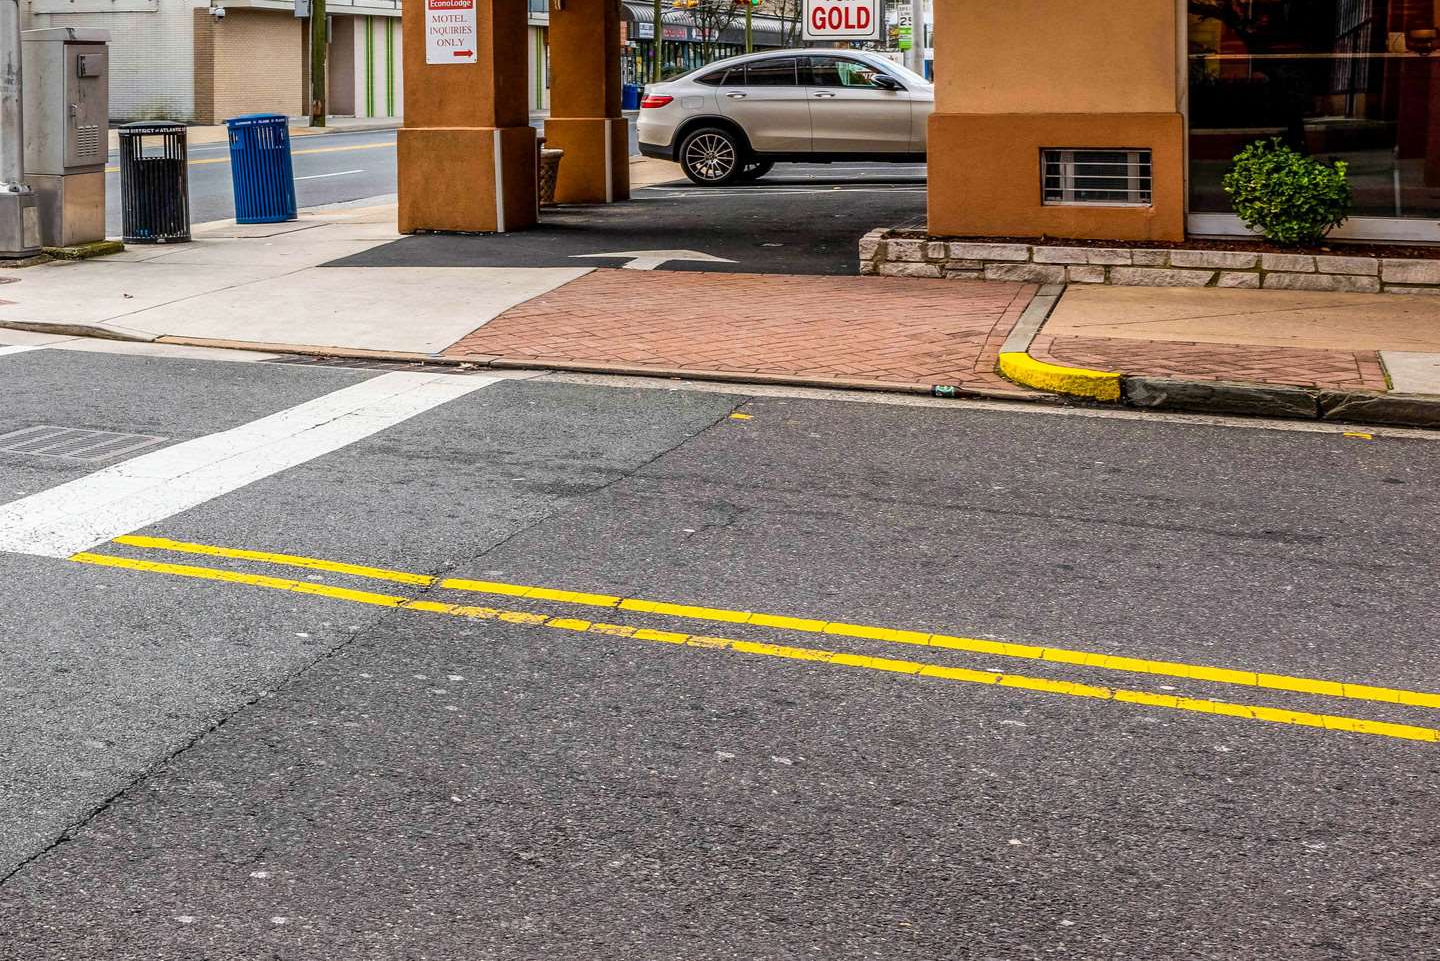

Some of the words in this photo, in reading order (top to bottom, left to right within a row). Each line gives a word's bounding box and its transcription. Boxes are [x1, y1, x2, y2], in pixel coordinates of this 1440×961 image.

[430, 0, 472, 7] EconoLodge
[432, 14, 466, 23] MOTEL
[811, 6, 871, 31] GOLD
[430, 25, 473, 36] INQUIRIES
[436, 38, 465, 47] ONLY
